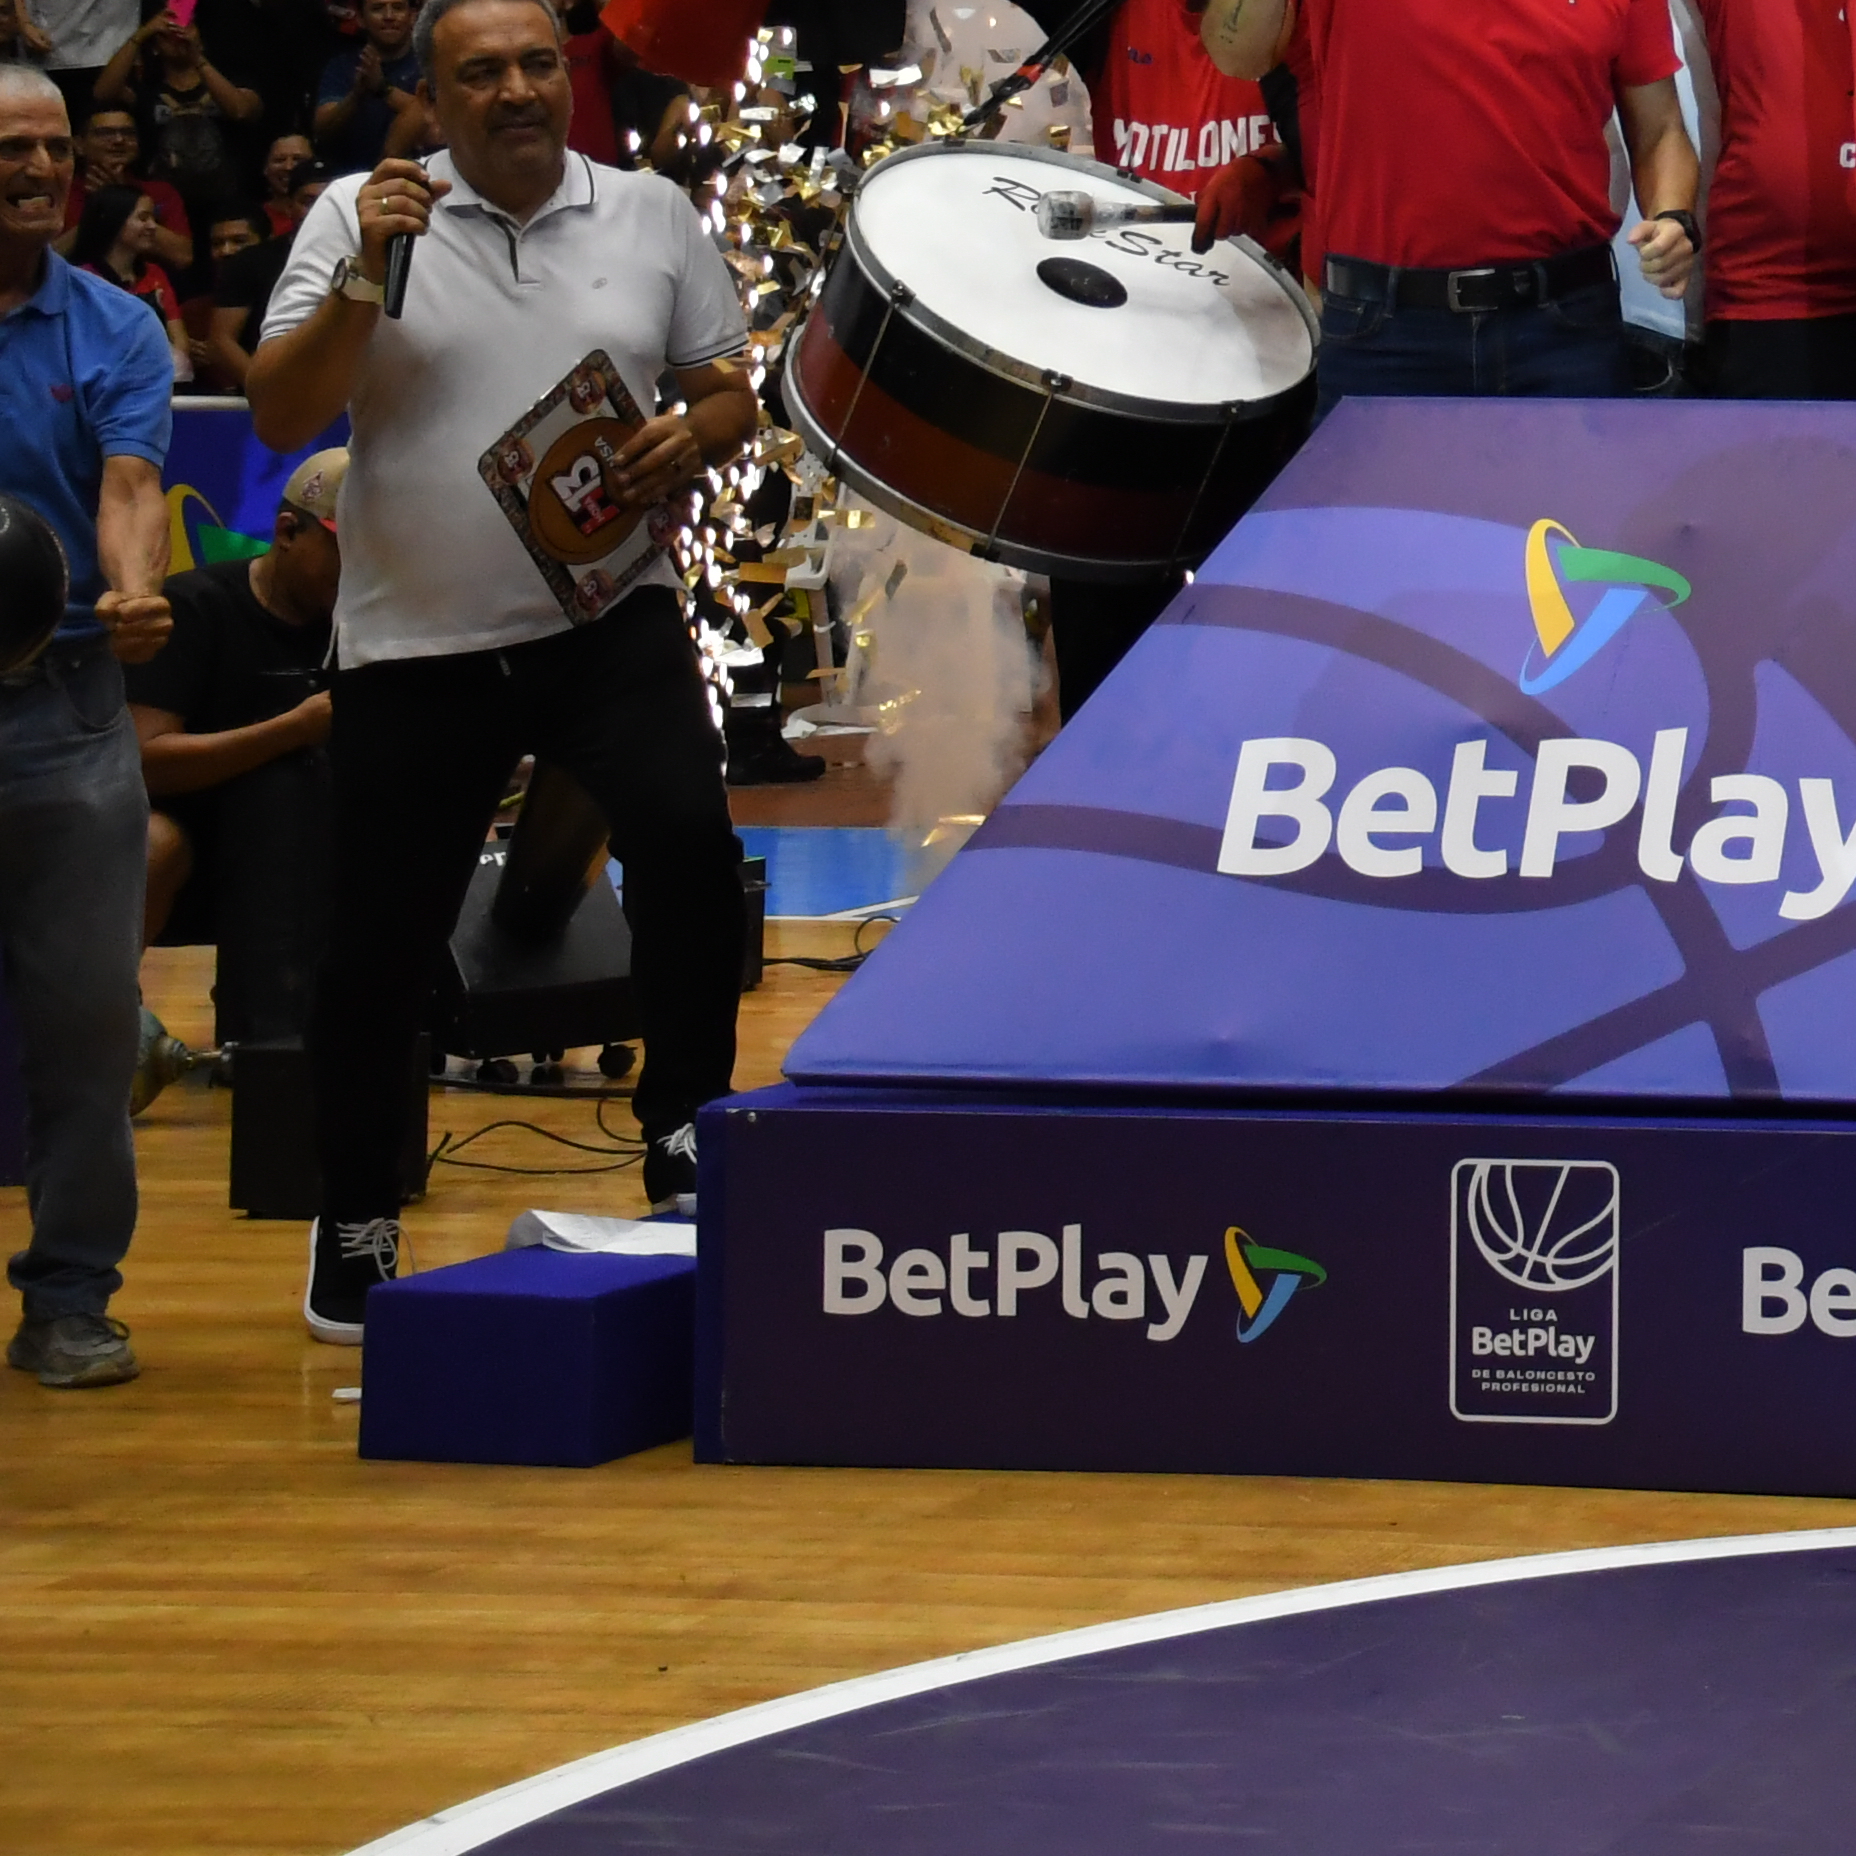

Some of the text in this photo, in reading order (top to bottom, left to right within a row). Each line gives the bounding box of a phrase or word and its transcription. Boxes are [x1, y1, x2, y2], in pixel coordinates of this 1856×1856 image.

[821, 1223, 1209, 1343] BetPlay
[1509, 1308, 1559, 1322] LIGA
[1471, 1325, 1596, 1365] BetPlay
[1471, 1369, 1596, 1382] DE BALONCESTO
[1481, 1382, 1587, 1394] PROFESIONAL
